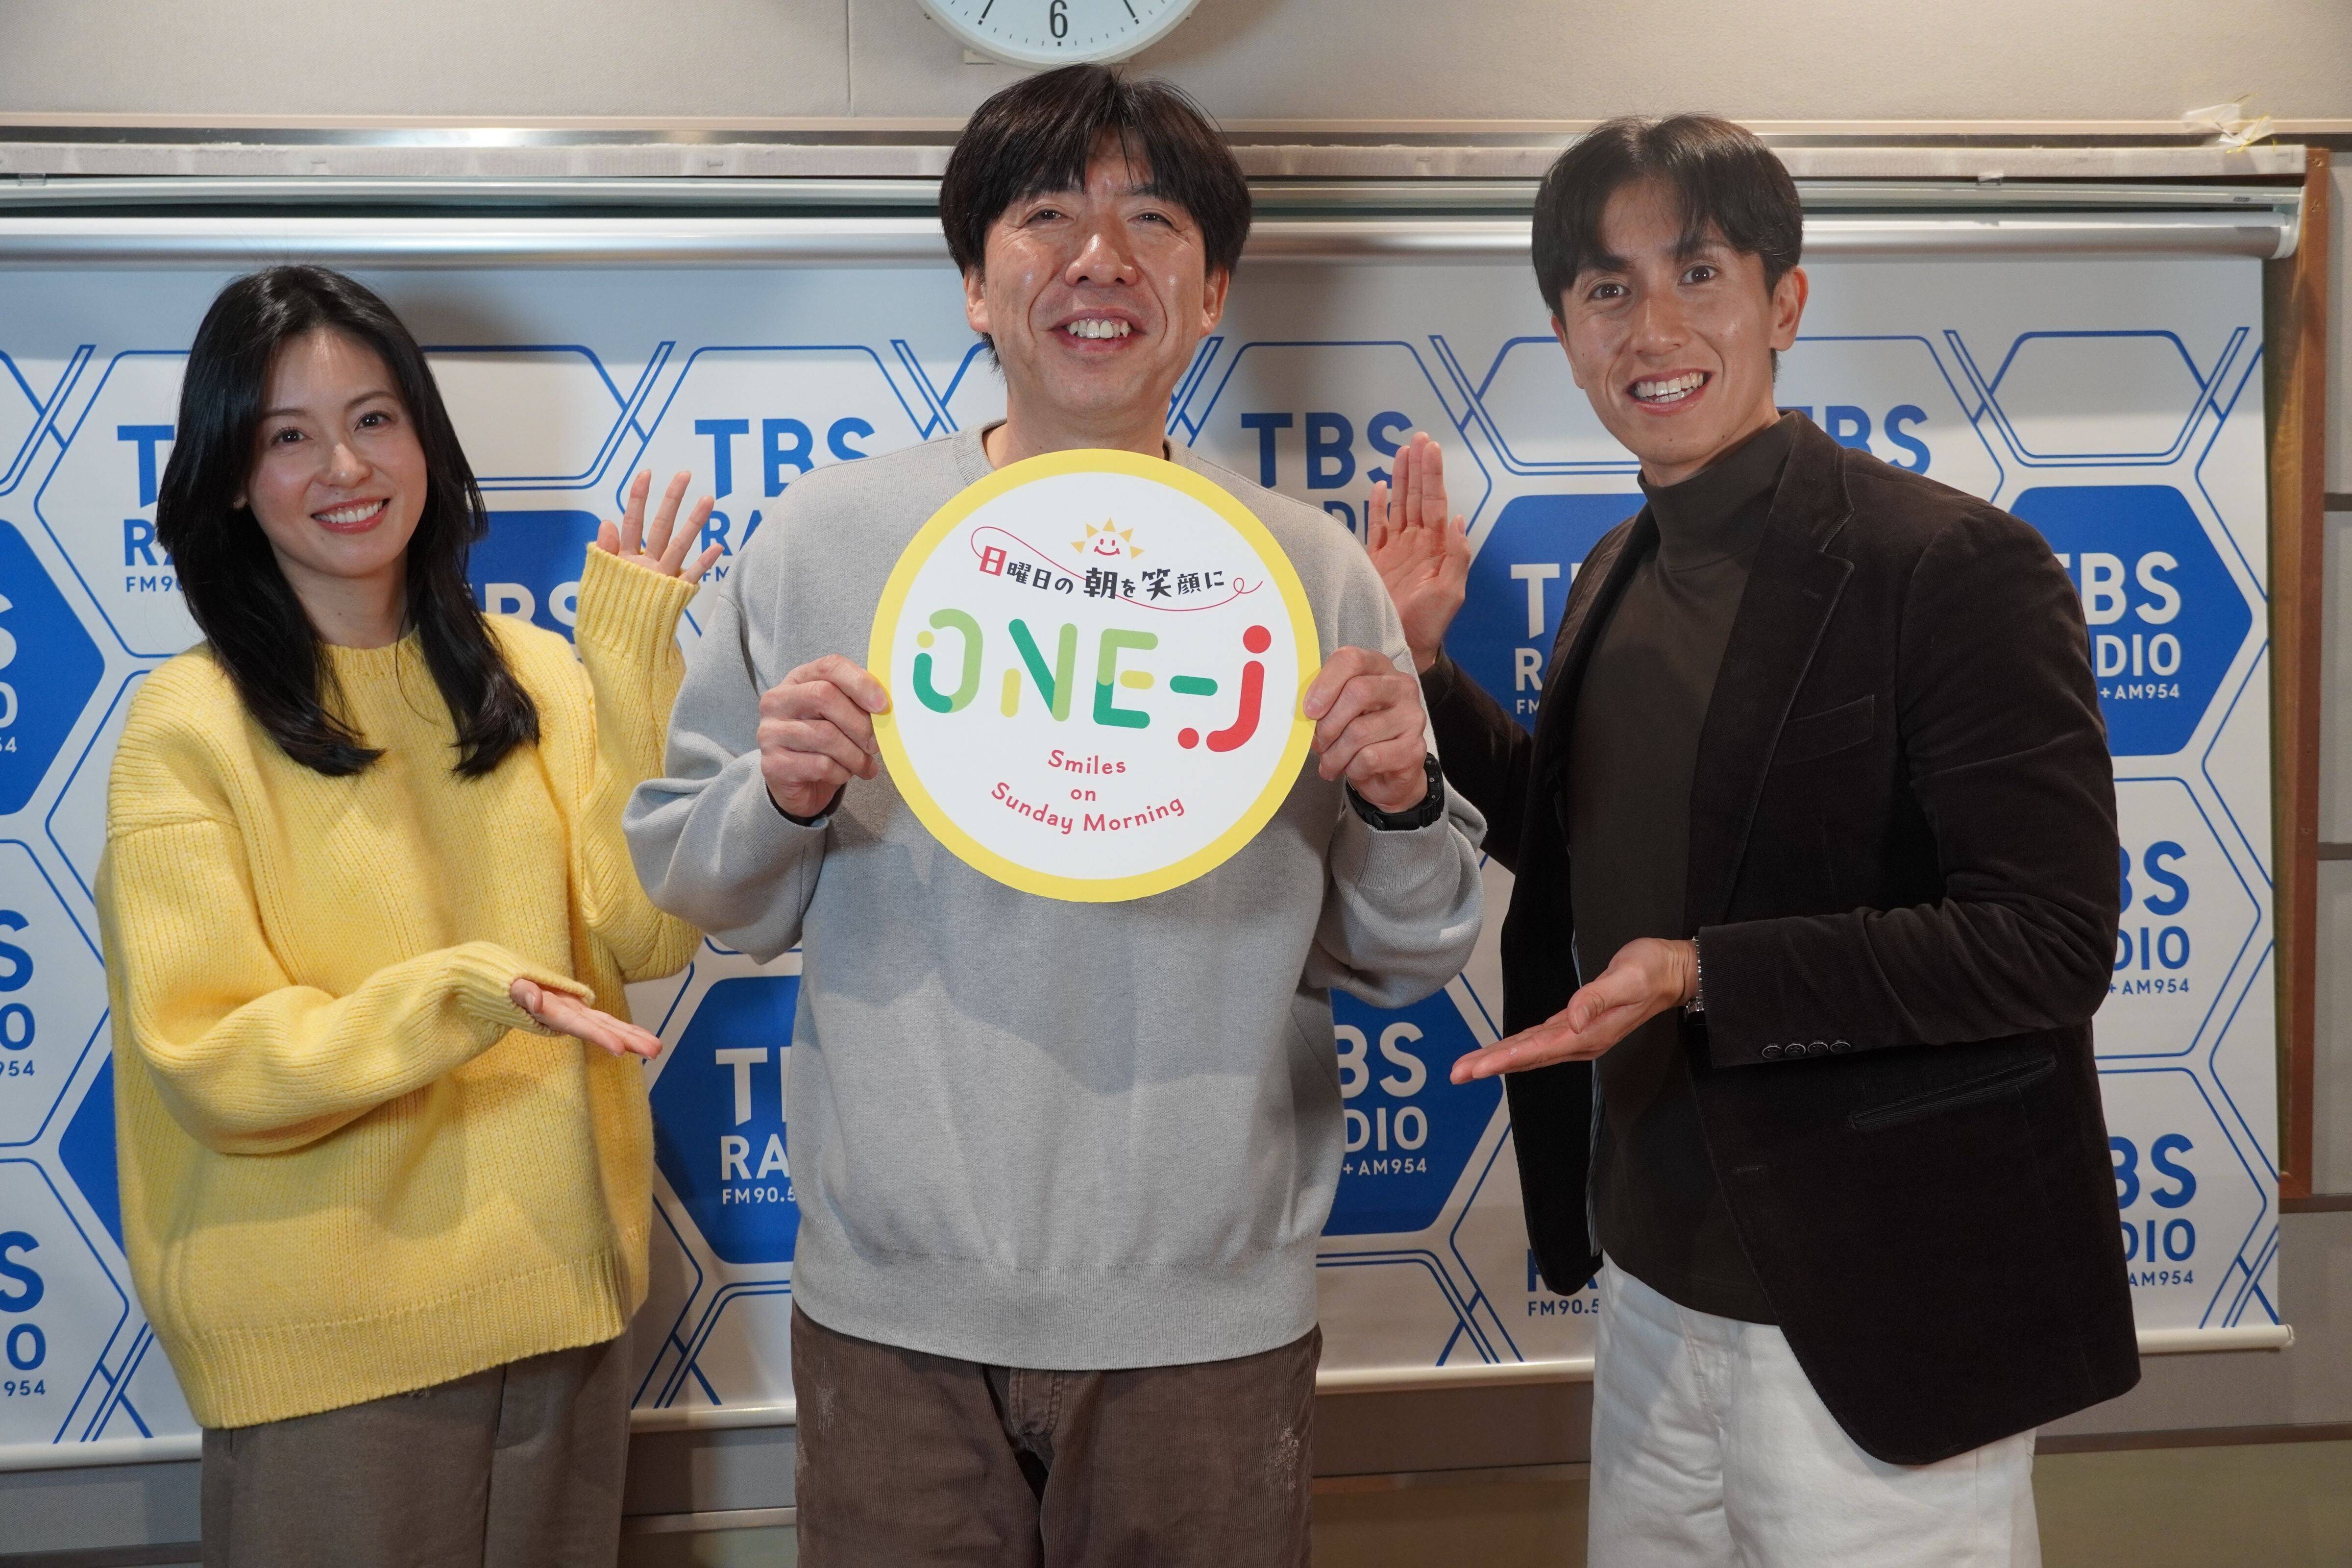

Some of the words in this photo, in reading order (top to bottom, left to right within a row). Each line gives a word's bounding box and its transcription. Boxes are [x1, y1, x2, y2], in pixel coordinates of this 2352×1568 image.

[1049, 0, 1069, 38] 6
[1241, 411, 1413, 489] TBS
[1777, 404, 1931, 475] BS
[2054, 551, 2181, 625] BS
[2096, 633, 2181, 678] DIO
[1048, 749, 1126, 775] Smiles
[991, 782, 1073, 835] Sunday
[1083, 798, 1185, 832] Morning
[1070, 788, 1096, 802] on
[2112, 926, 2190, 971] DIO
[1334, 1022, 1426, 1099] BS
[1345, 1106, 1428, 1153] DIO
[2109, 1133, 2196, 1209] BS
